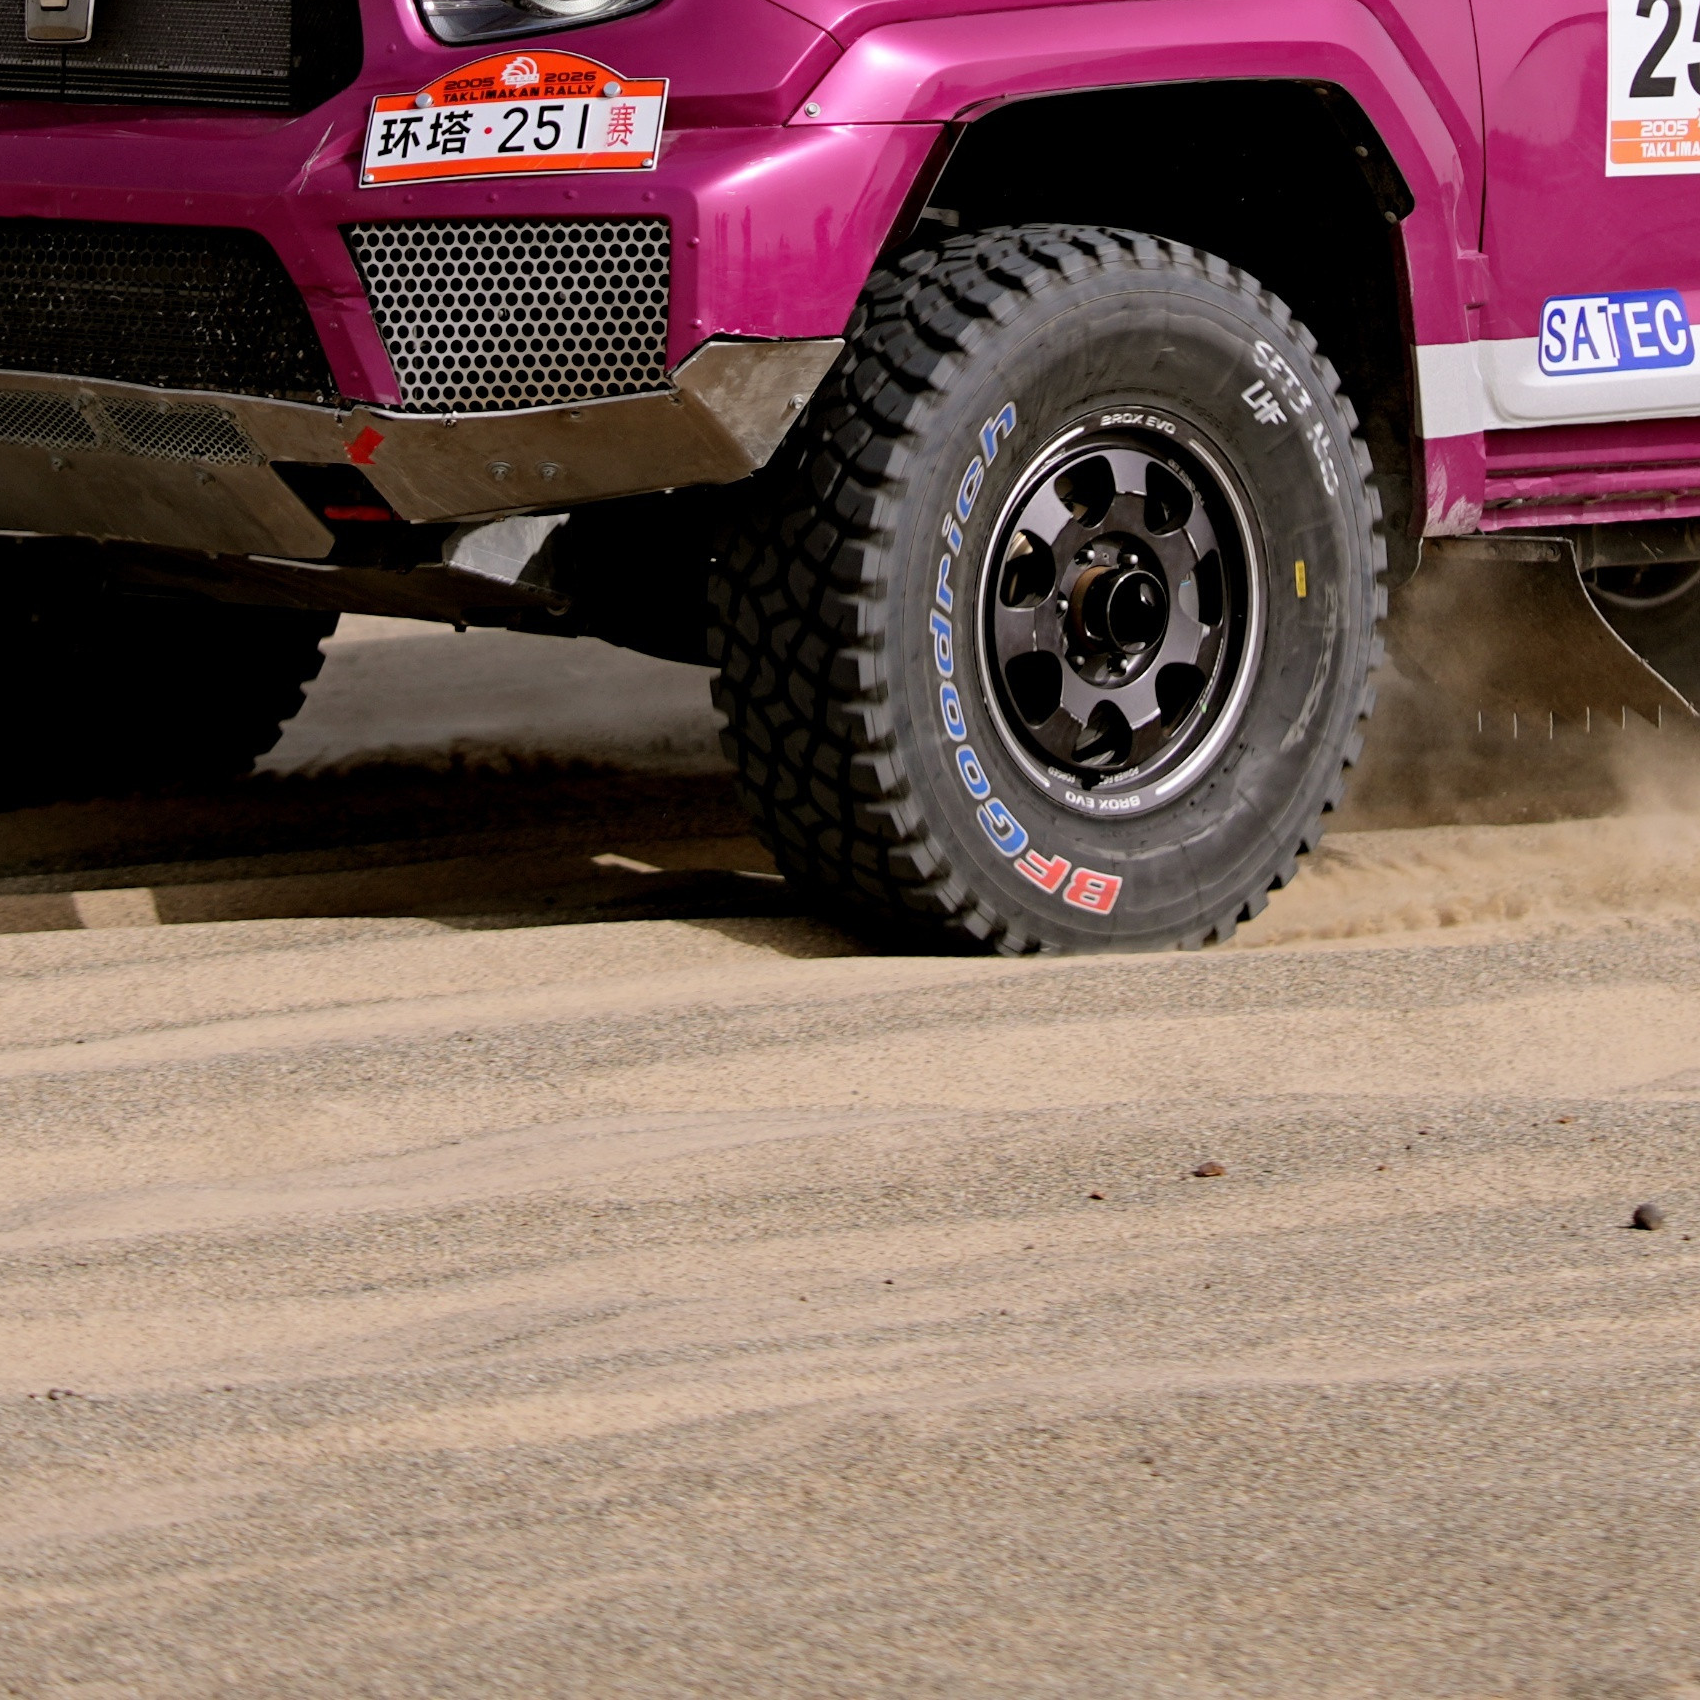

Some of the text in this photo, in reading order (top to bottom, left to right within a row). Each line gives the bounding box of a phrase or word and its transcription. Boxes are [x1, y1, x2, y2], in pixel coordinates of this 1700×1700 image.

[442, 76, 495, 91] 2005
[543, 71, 598, 83] 2026
[442, 84, 596, 103] TAKLIMAKAN RALLY
[1640, 119, 1689, 137] 2005
[1543, 298, 1690, 365] SATEC
[1100, 412, 1177, 435] BROX EVO
[1064, 789, 1142, 811] BROX EVO
